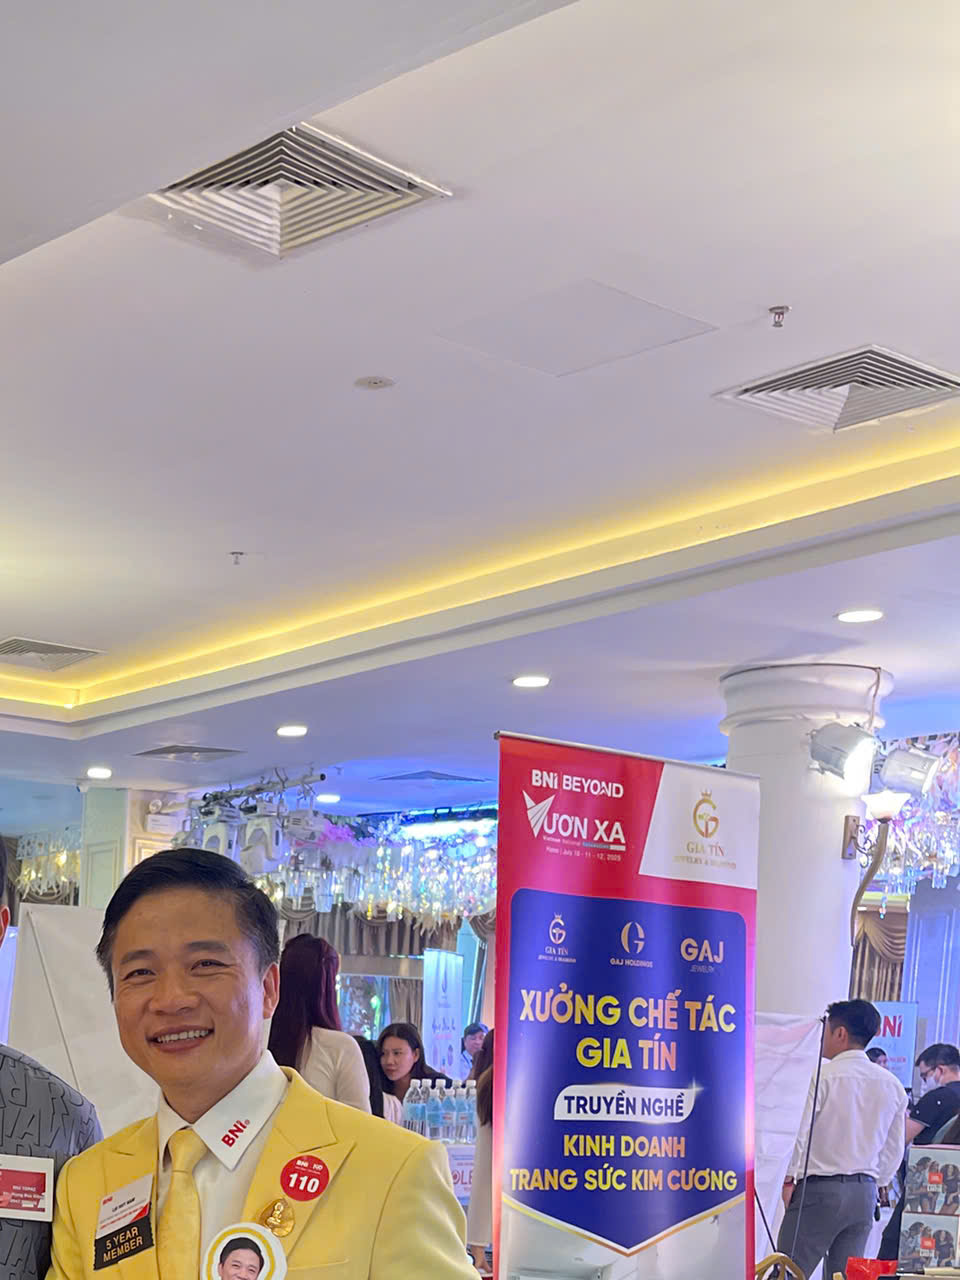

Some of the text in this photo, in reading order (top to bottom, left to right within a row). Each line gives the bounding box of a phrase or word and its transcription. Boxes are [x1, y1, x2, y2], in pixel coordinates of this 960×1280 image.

[562, 774, 624, 798] BEYOND
[593, 819, 626, 844] XA
[680, 938, 725, 964] GAJ
[519, 982, 736, 1033] XƯỞNG CHẾ TÁC
[575, 1033, 677, 1072] GIA TÍN
[563, 1090, 685, 1118] TRUYỀN NGHỀ
[563, 1134, 686, 1158] KINH DOANH
[289, 1172, 320, 1193] 110
[509, 1163, 738, 1192] TRANG SỨC KIM CƯƠNG
[103, 1236, 143, 1262] MEMBER
[105, 1226, 139, 1250] 5 YEAR
